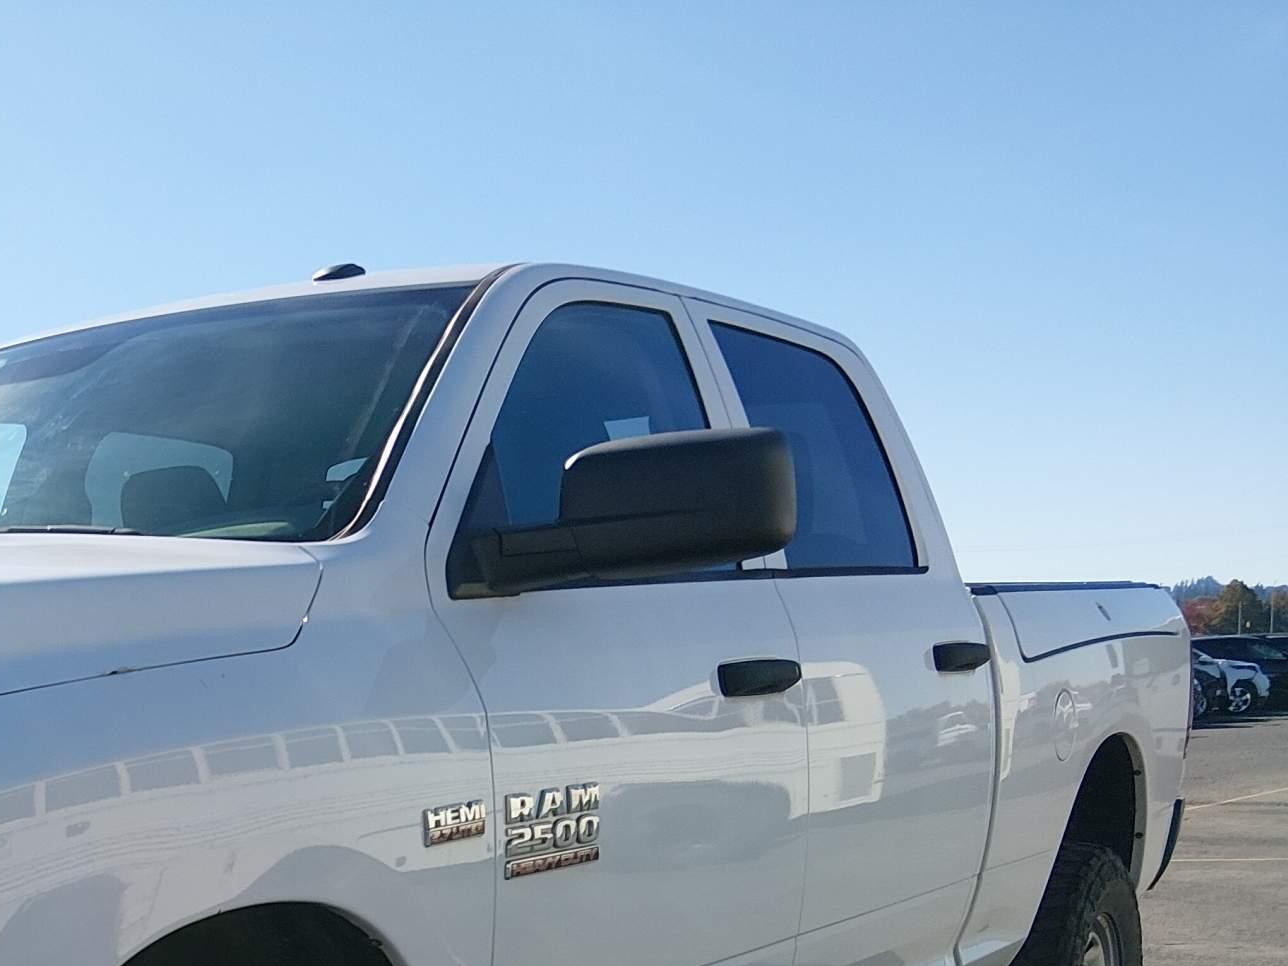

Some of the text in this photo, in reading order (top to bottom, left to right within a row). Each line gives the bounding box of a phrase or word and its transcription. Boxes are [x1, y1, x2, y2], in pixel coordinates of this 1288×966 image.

[425, 801, 487, 829] HEMI
[506, 782, 600, 822] RAM
[506, 815, 600, 853] 2500
